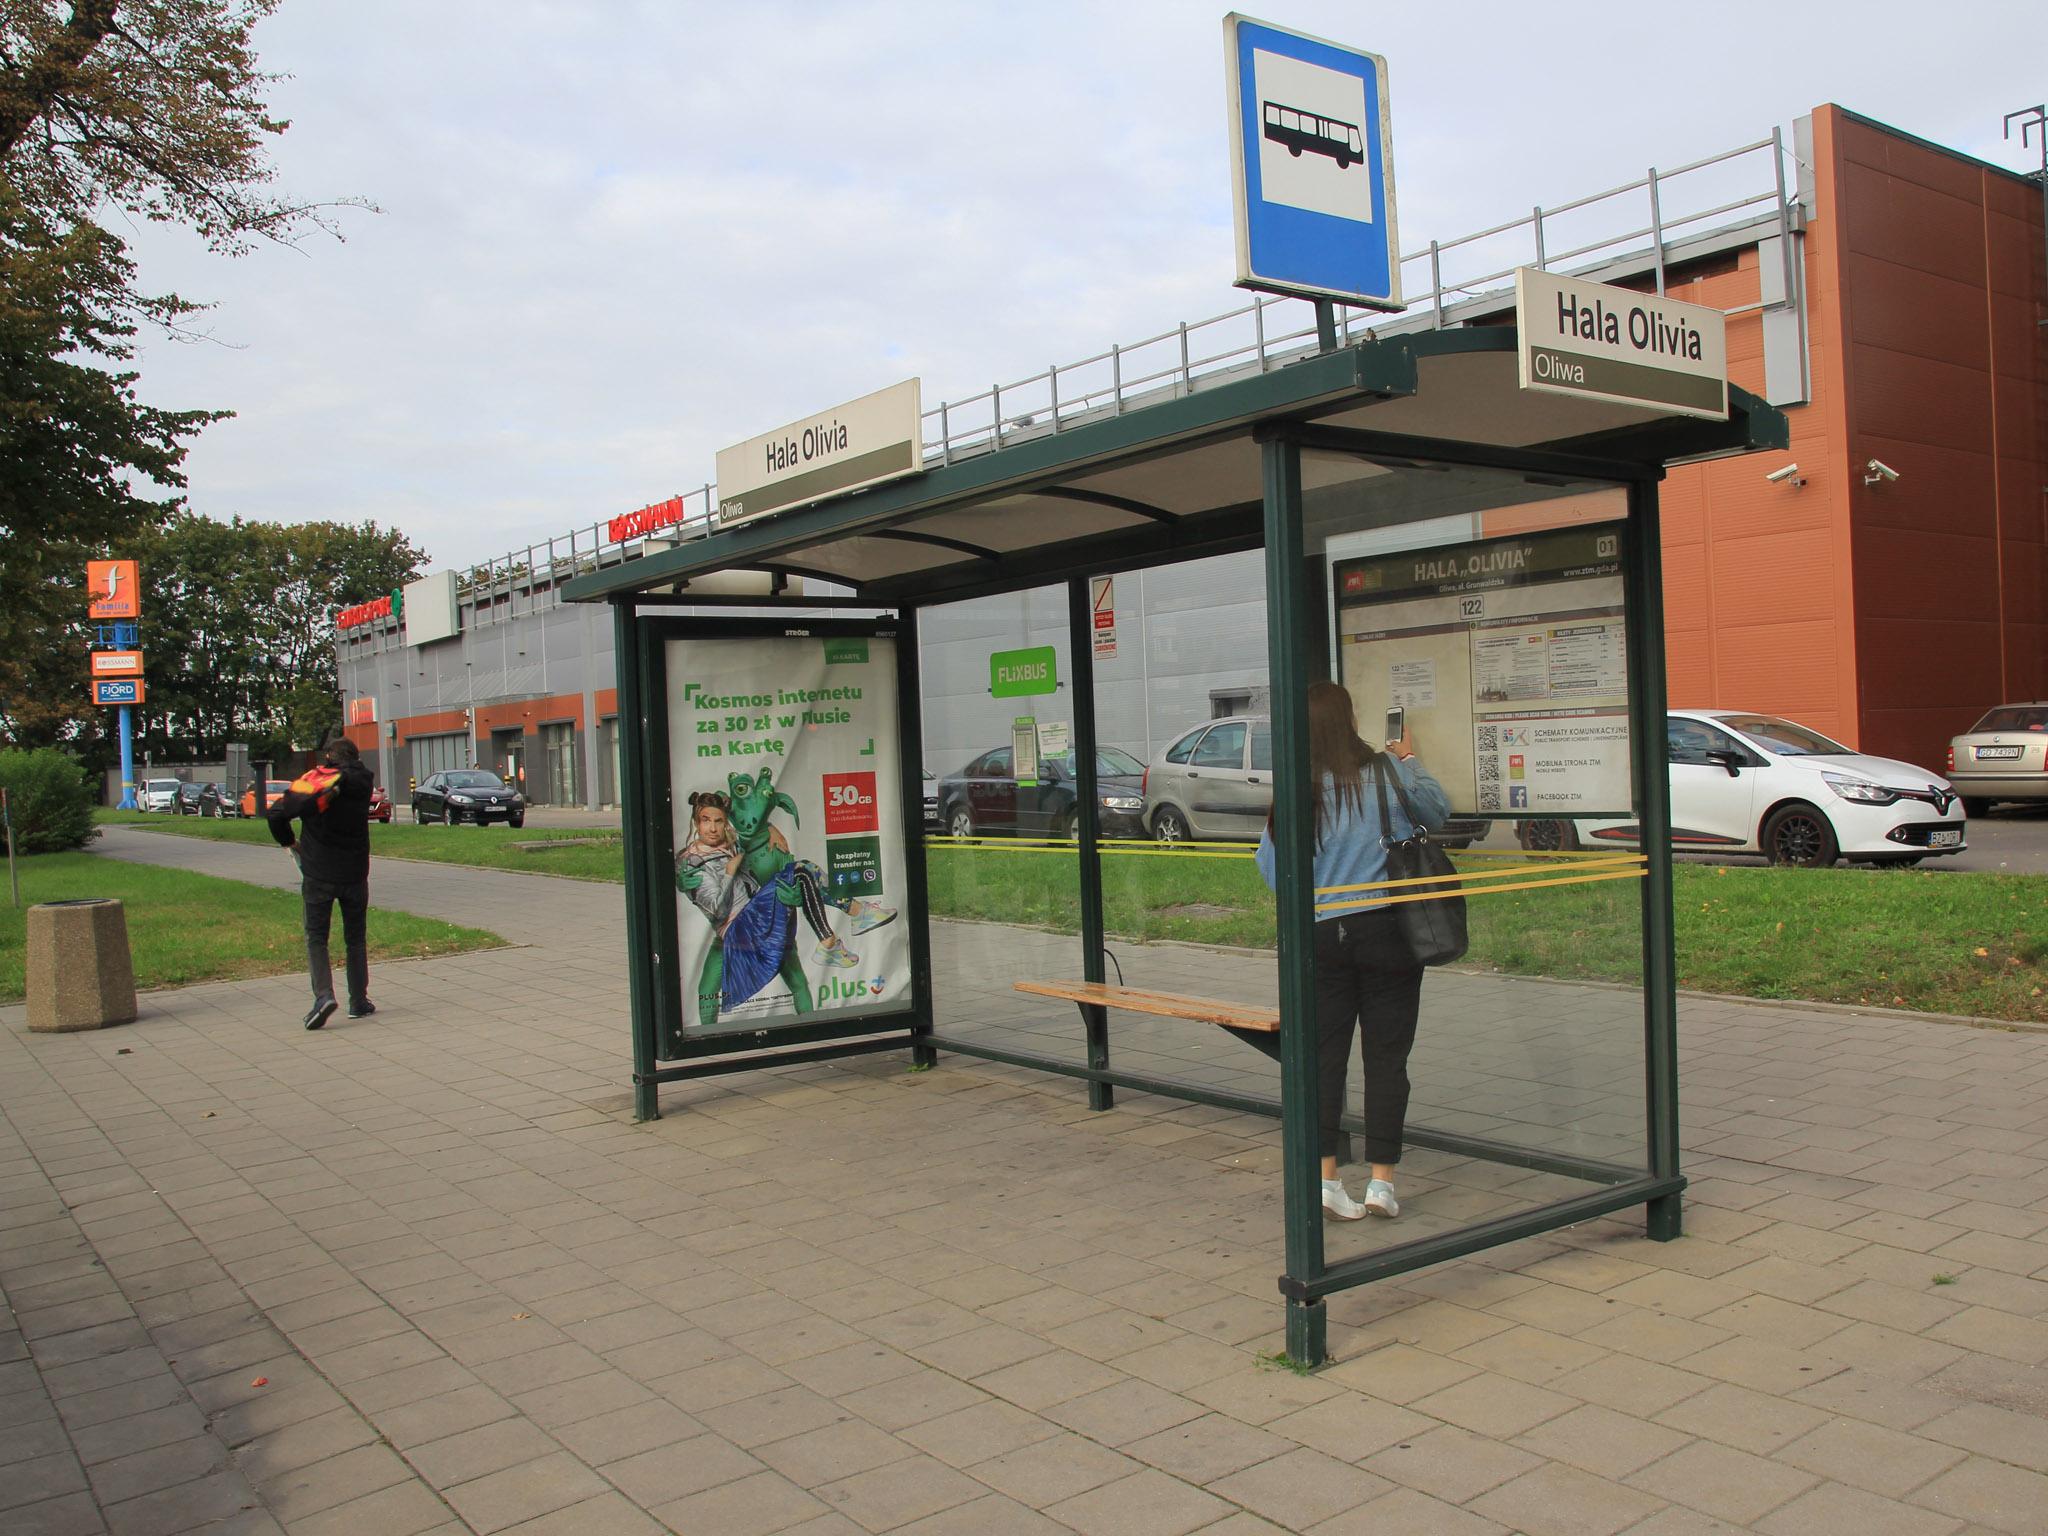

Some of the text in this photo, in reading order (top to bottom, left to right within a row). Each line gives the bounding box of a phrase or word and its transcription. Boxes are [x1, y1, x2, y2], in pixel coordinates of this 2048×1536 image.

[1557, 290, 1702, 361] Hala Olivia
[1535, 353, 1585, 384] Oliwa
[766, 419, 848, 474] Hala Olivia
[721, 501, 744, 519] Oliwa
[1598, 541, 1614, 554] 01
[1414, 559, 1458, 581] HALA
[1461, 598, 1483, 616] 122
[784, 629, 810, 637] STRÖER
[101, 685, 134, 695] FJORD
[694, 686, 862, 710] Kosmos internetu
[696, 720, 719, 734] za
[724, 716, 748, 732] 30
[753, 715, 772, 731] zł
[777, 715, 796, 728] w
[1534, 726, 1628, 737] SCHEMATY KOMUNIKACYJNE
[697, 738, 784, 757] na Kartę
[1564, 759, 1587, 767] STRONA
[1536, 793, 1569, 801] FACEBOOK
[836, 851, 871, 860] bezpłatny
[833, 861, 862, 869] transfer
[817, 976, 867, 1008] plus
